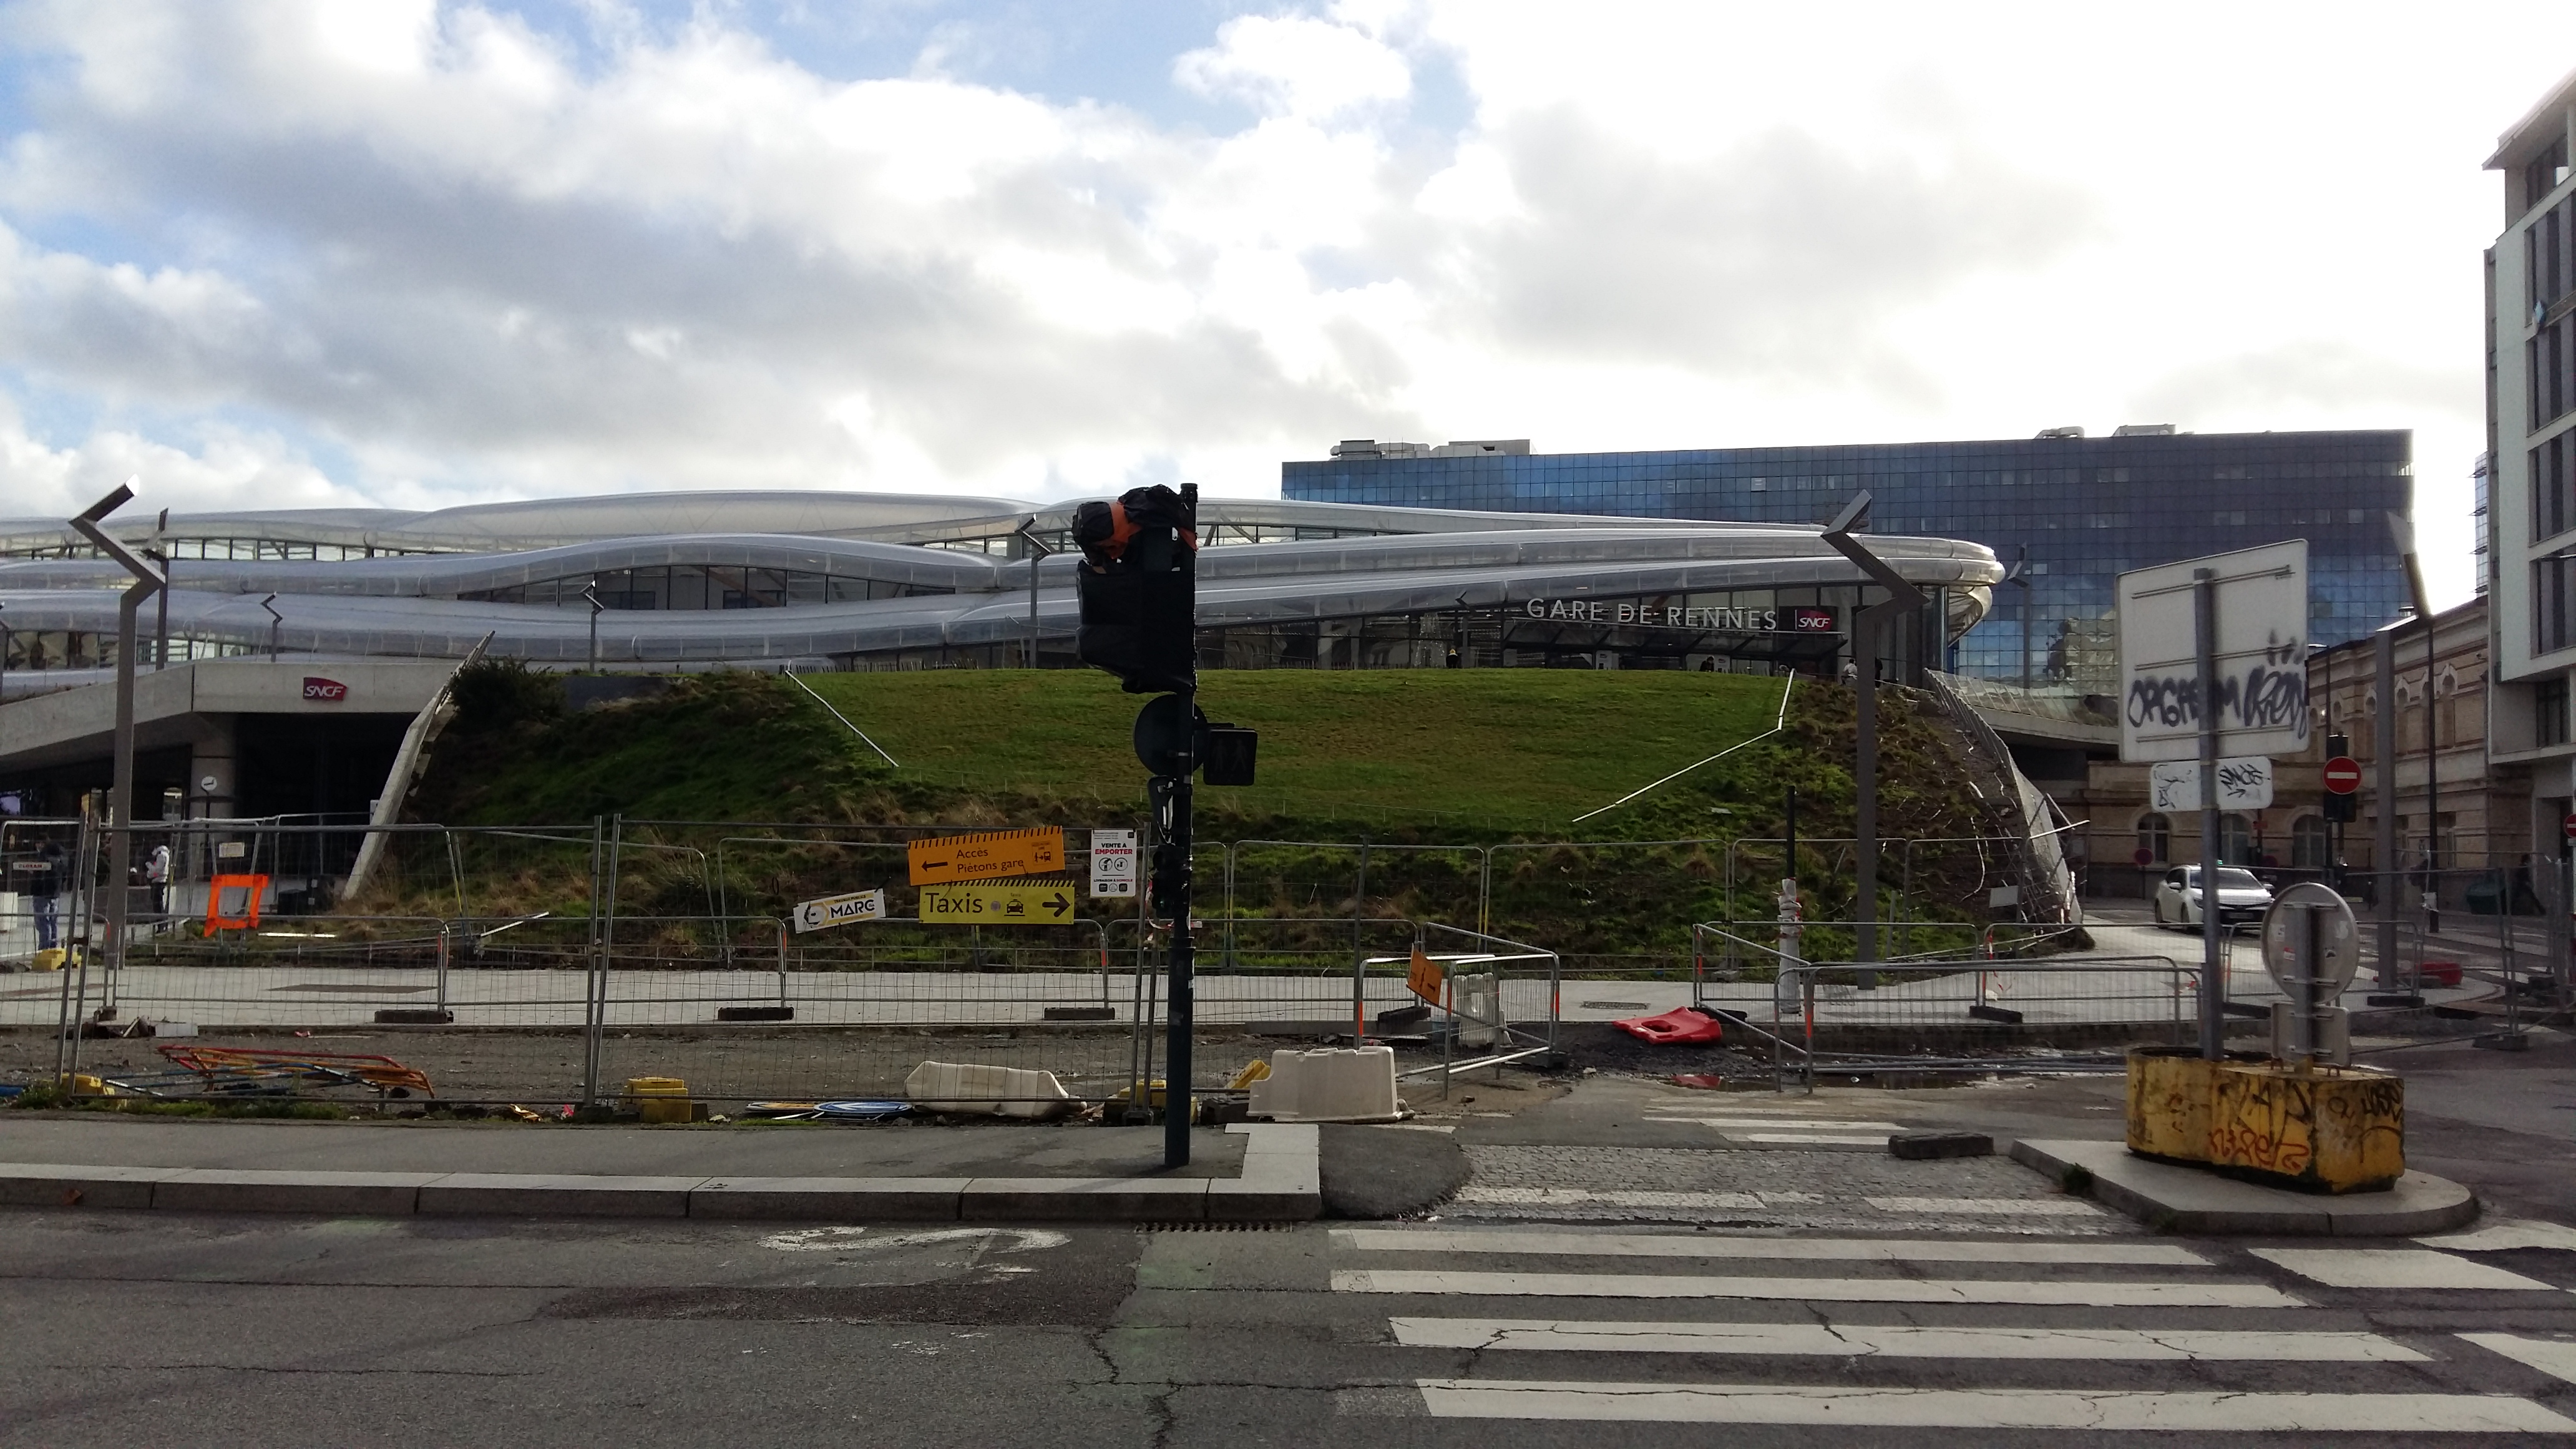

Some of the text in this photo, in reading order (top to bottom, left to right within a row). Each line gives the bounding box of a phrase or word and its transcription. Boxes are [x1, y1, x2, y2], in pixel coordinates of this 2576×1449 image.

[1526, 598, 1776, 630] GARE DE RENNES
[1798, 617, 1831, 629] SNCF
[304, 685, 344, 698] SNCF
[956, 847, 988, 859] Accès
[957, 859, 1024, 874] Piétons gare
[830, 899, 875, 919] MARC
[925, 892, 983, 913] Taxis
